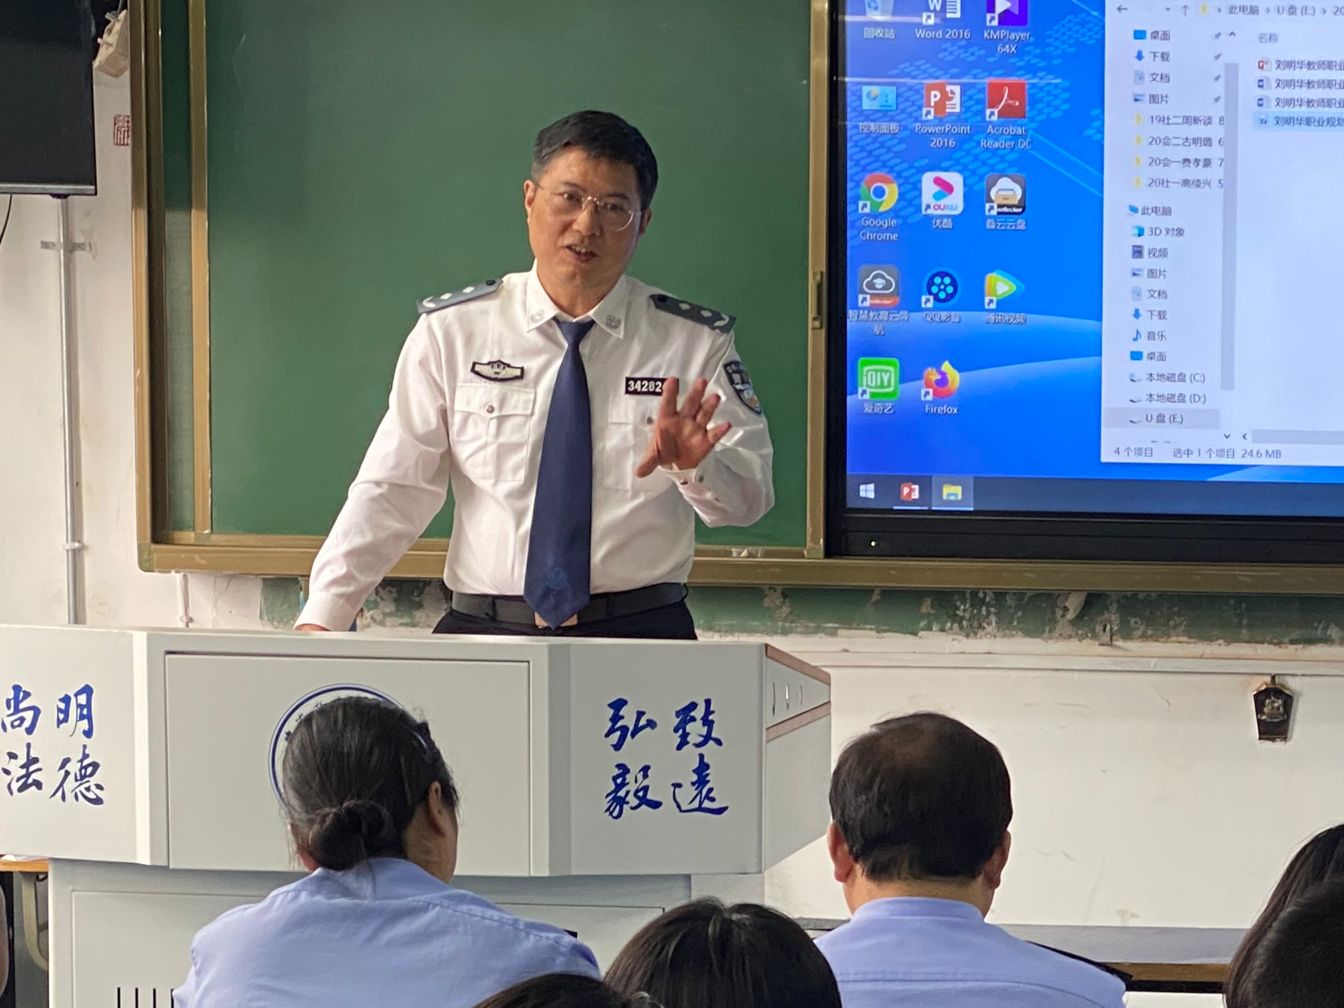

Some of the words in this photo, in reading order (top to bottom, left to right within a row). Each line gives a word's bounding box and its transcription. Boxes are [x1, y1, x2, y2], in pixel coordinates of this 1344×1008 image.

[1228, 5, 1260, 16] 此电脑
[863, 28, 895, 39] 回收站
[915, 28, 943, 39] Word
[945, 29, 971, 39] 2016
[984, 29, 1031, 41] KMPlayer
[1150, 30, 1171, 41] 桌面
[1257, 33, 1279, 44] 名称
[997, 43, 1017, 54] 64X
[1150, 51, 1170, 62] 下载
[1150, 72, 1170, 83] 文档
[1149, 94, 1169, 105] 图片
[915, 123, 971, 135] PowerPoint
[987, 125, 1026, 136] Acrobat
[930, 138, 956, 148] 2016
[981, 139, 1015, 149] Reader
[1017, 139, 1032, 149] DC
[1141, 206, 1172, 216] 此电脑
[861, 217, 897, 229] Google
[860, 231, 899, 241] Chrome
[1147, 227, 1162, 236] 3D
[1164, 226, 1185, 237] 对象
[1147, 247, 1168, 258] 视频
[1147, 268, 1167, 279] 图片
[1147, 289, 1168, 300] 文档
[1147, 310, 1168, 321] 下载
[1147, 330, 1167, 341] 音乐
[1147, 351, 1167, 362] 桌面
[1146, 372, 1186, 383] 本地磁盘
[1146, 393, 1186, 404] 本地磁盘
[925, 403, 959, 414] Firefox
[1156, 413, 1166, 424] 盘
[1122, 447, 1154, 458] 个项目
[1173, 448, 1193, 459] 选中
[1204, 448, 1235, 459] 个项目
[1241, 448, 1262, 458] 24.6
[1265, 449, 1282, 459] MB
[1, 684, 44, 797] 尚法
[49, 683, 105, 806] 明德
